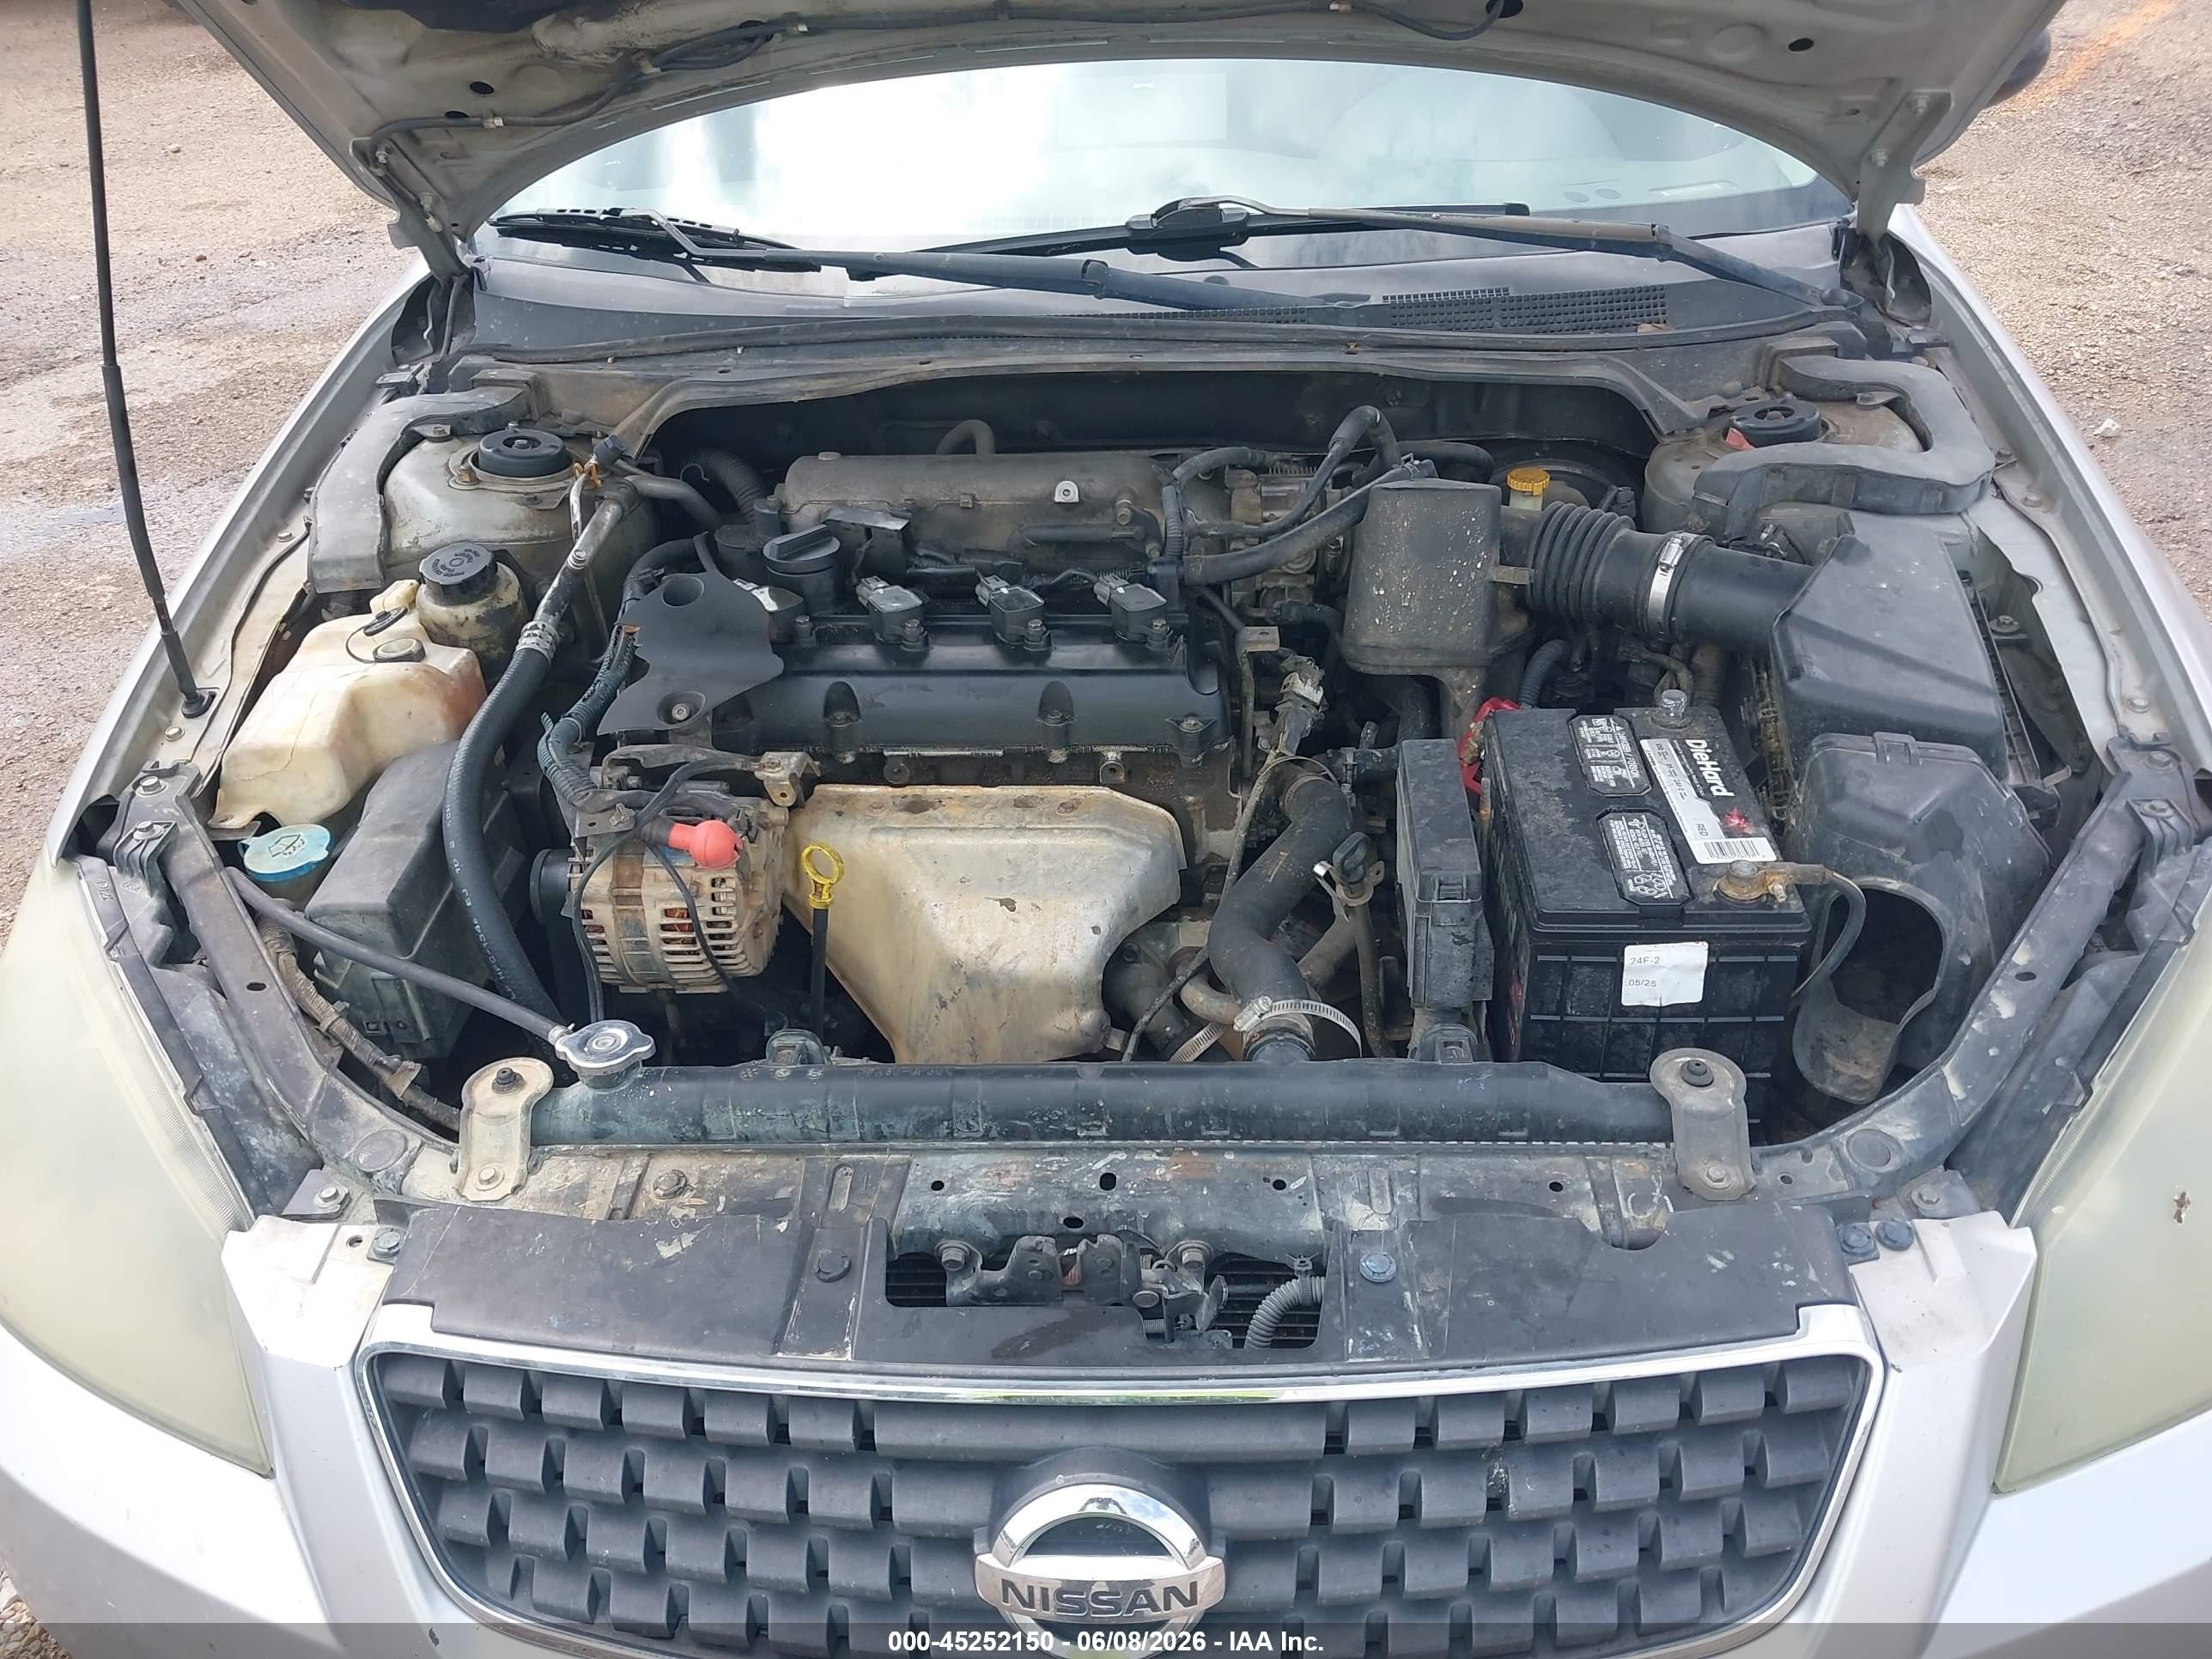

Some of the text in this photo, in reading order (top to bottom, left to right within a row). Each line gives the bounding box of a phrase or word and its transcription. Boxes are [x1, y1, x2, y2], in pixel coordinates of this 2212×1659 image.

[1685, 739, 1735, 797] DieHard
[1695, 822, 1710, 837] RED
[1629, 956, 1661, 965] 24F-2
[1628, 978, 1657, 988] 05/25
[1001, 1578, 1200, 1618] NISSAN
